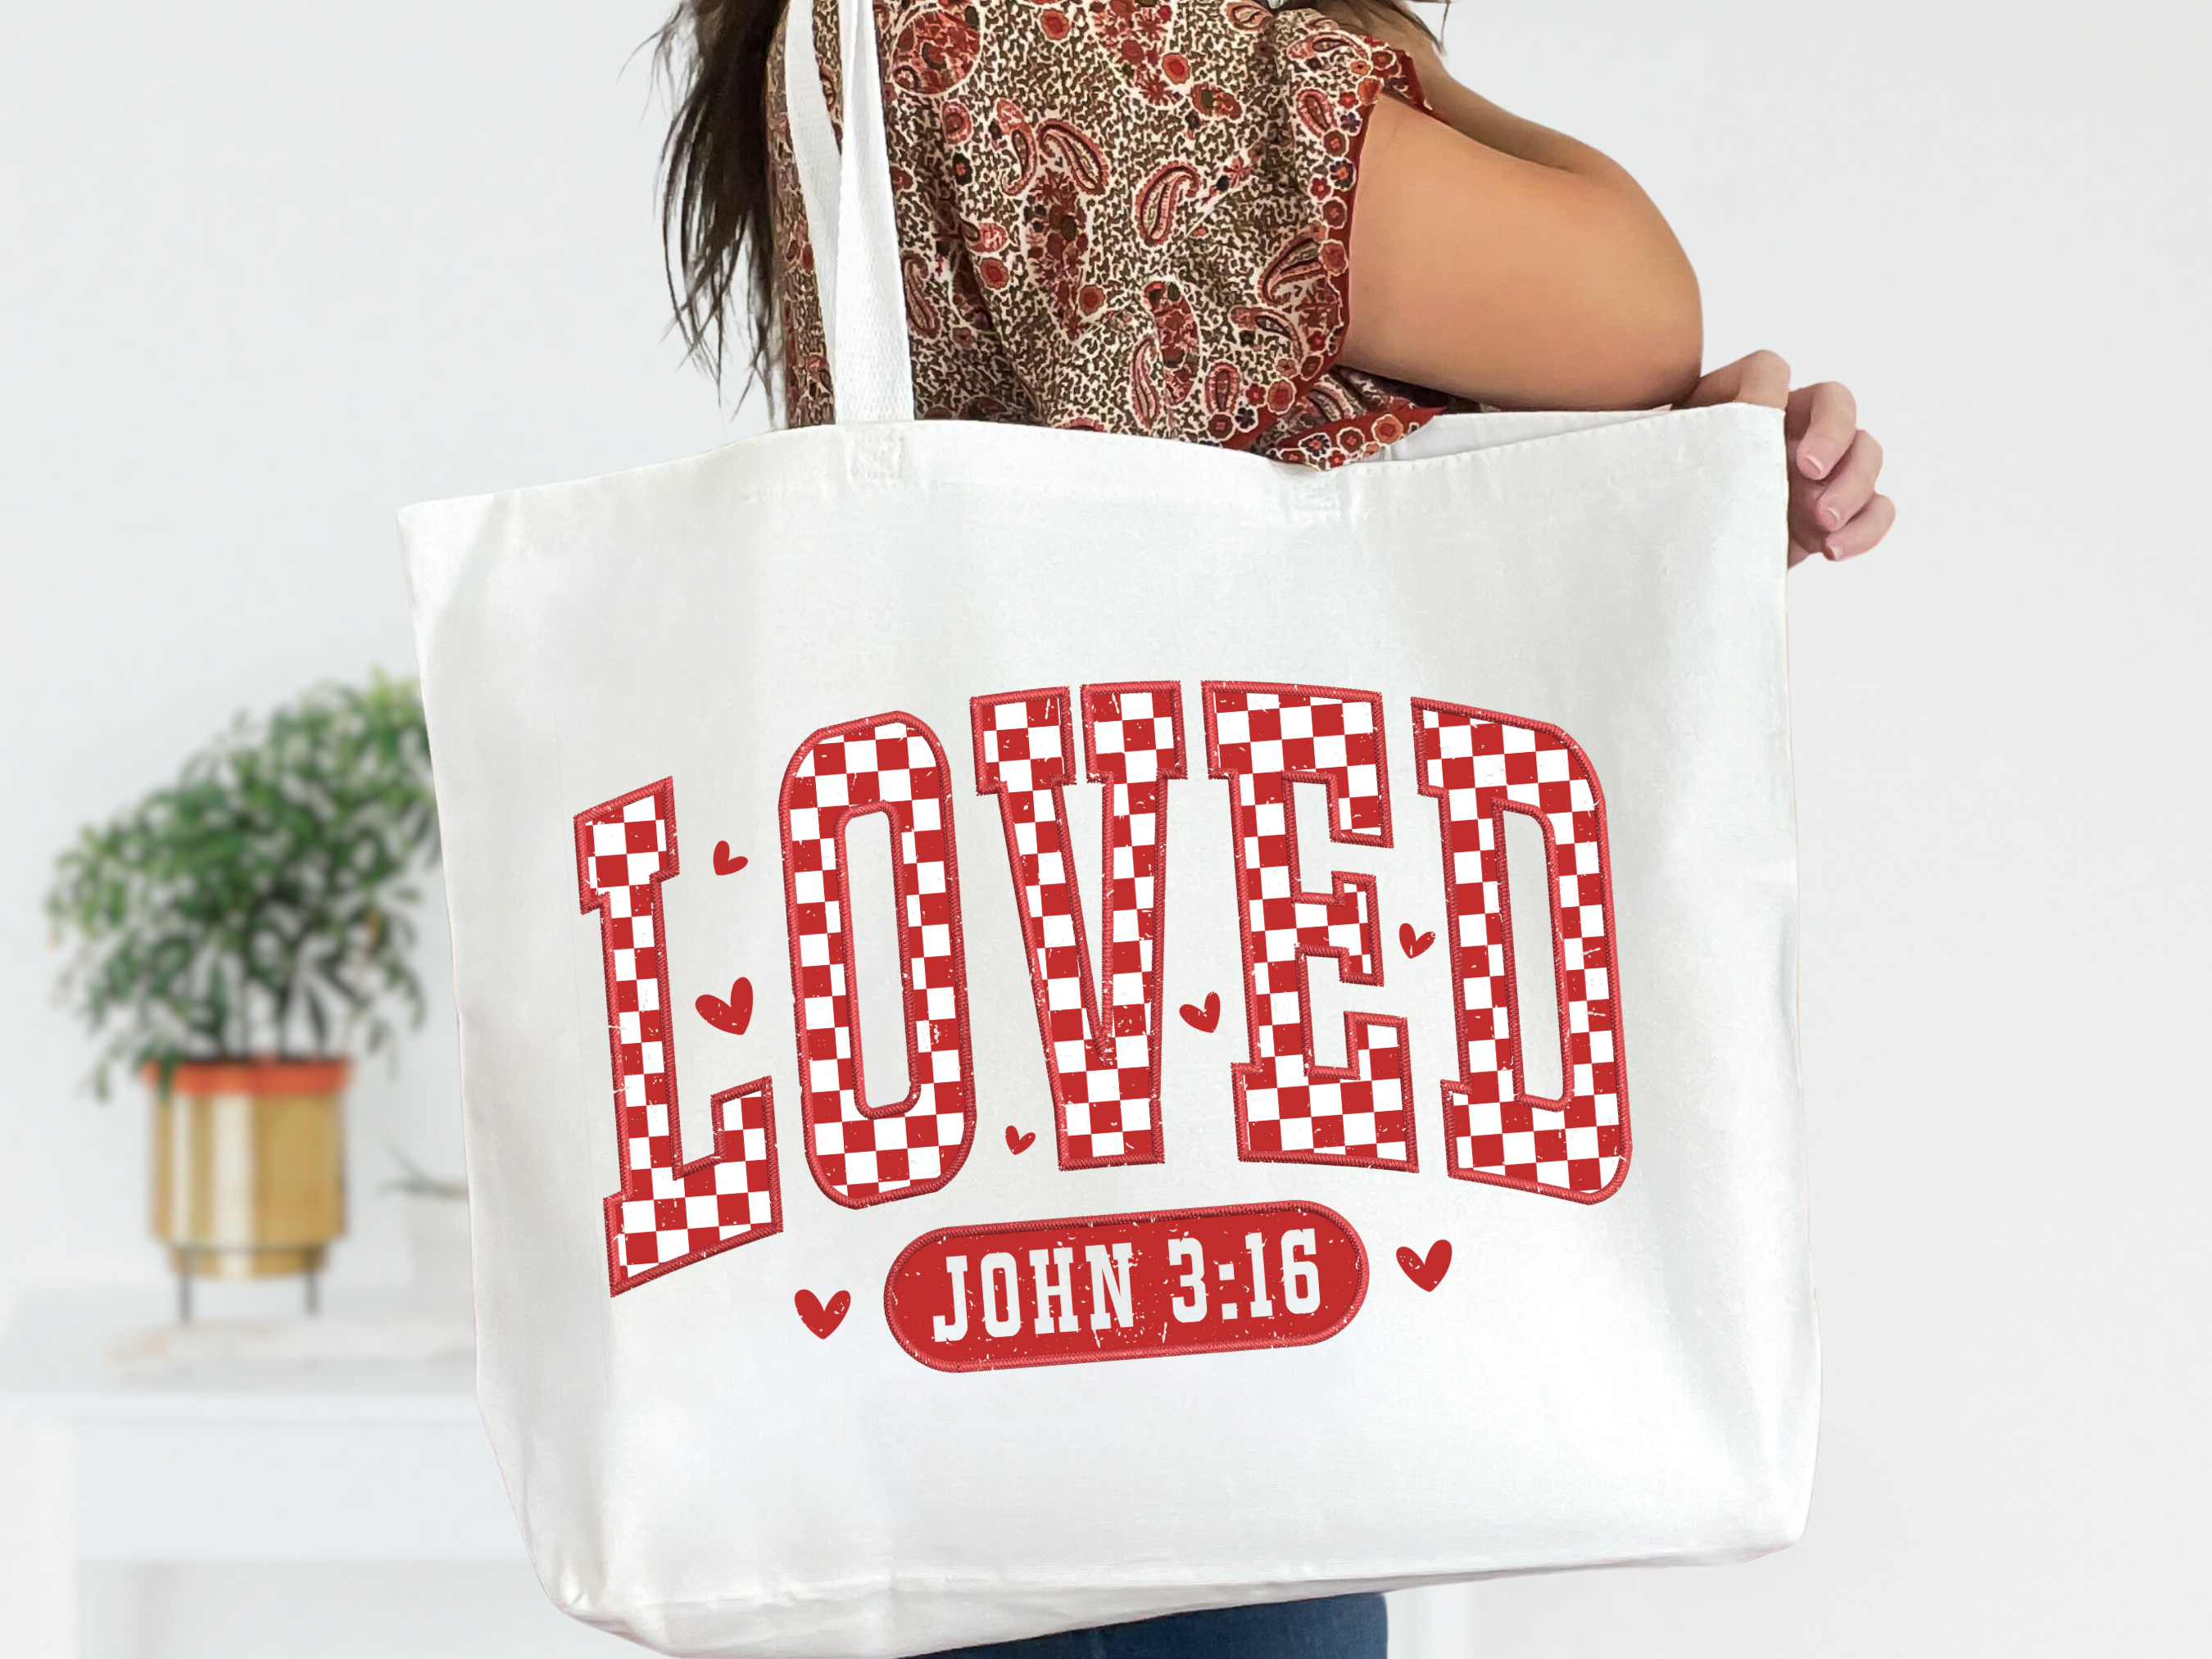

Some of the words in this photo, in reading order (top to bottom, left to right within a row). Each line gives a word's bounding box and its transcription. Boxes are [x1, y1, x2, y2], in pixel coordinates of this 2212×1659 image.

[573, 680, 1633, 1298] LOVED
[932, 1242, 1136, 1343] JOHN
[1168, 1229, 1320, 1323] 3:16
